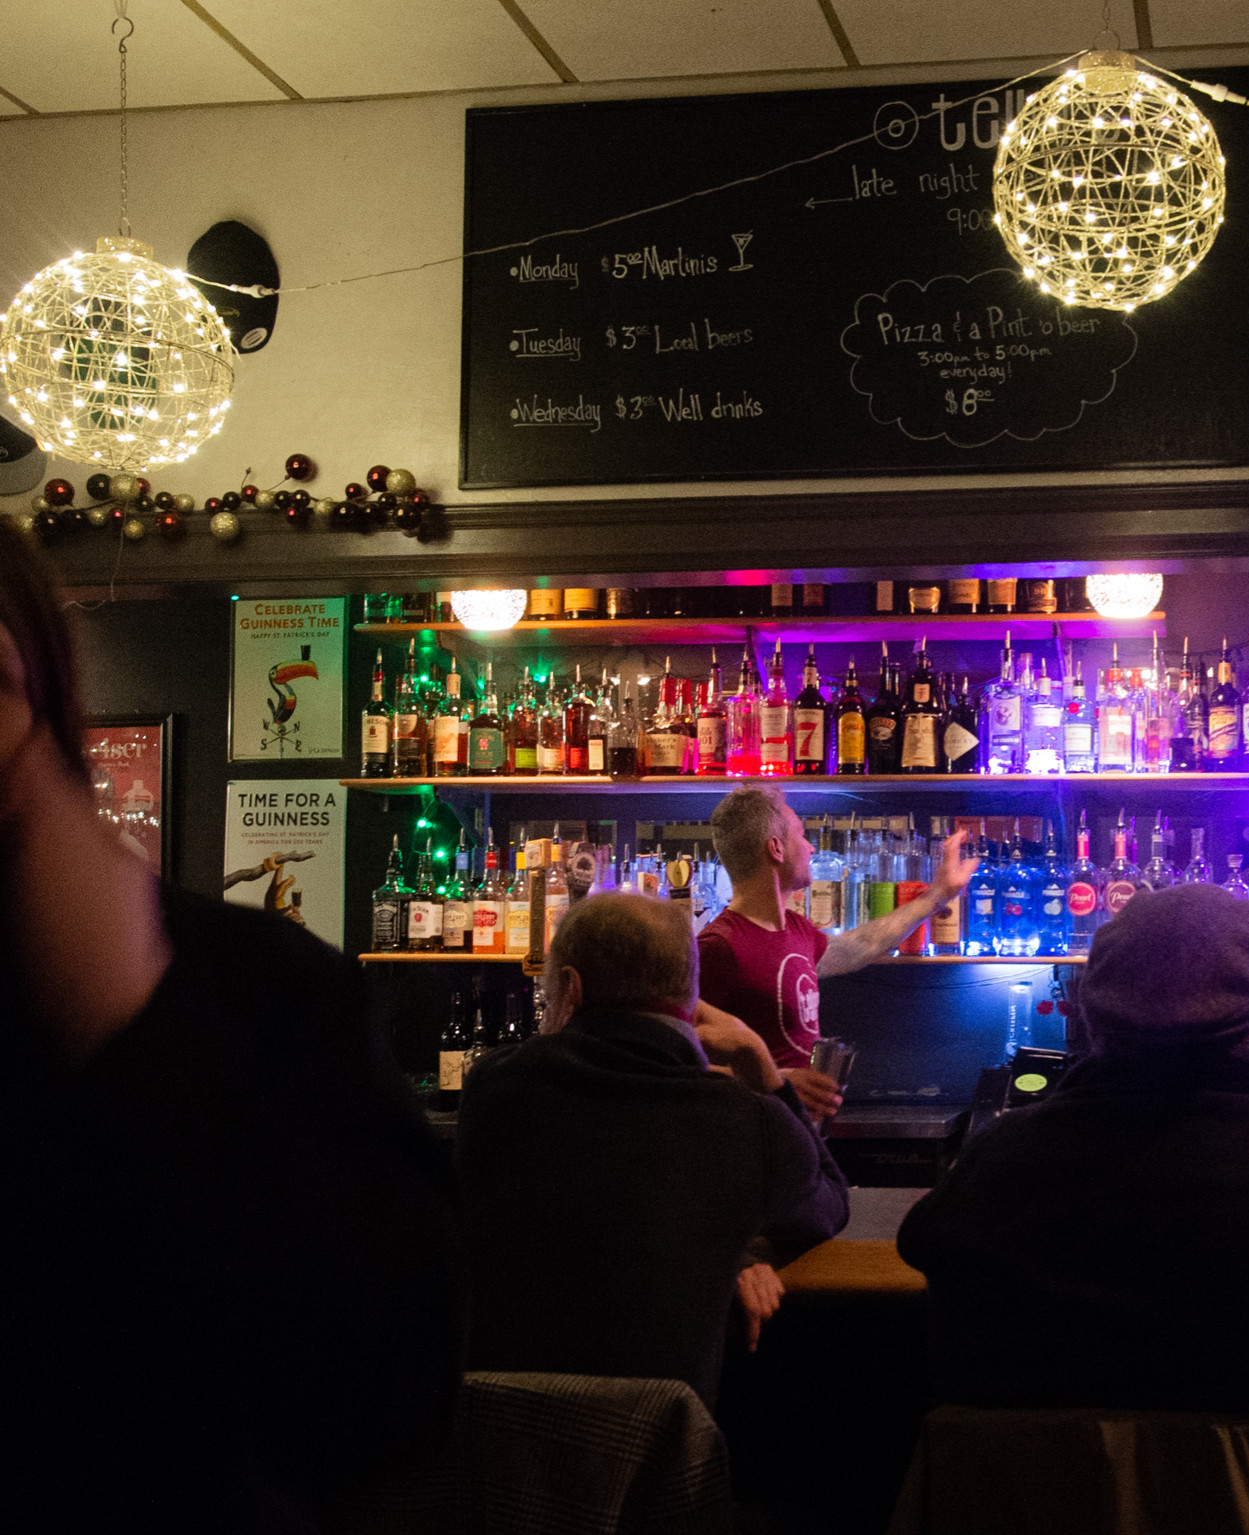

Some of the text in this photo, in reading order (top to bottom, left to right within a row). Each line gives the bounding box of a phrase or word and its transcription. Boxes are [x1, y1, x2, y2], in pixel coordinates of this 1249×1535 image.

[851, 164, 897, 199] late
[919, 163, 980, 200] night
[519, 254, 579, 290] Monday
[877, 312, 944, 345] Pizza
[968, 321, 981, 340] a
[986, 305, 1032, 339] Pint
[1055, 306, 1101, 336] beer
[513, 327, 581, 361] Tuesday
[704, 318, 753, 350] beers
[974, 346, 990, 361] to
[515, 394, 601, 433] Wednesday
[658, 387, 703, 422] Well
[711, 391, 763, 419] drinks
[254, 603, 325, 616] CELEBRATE
[240, 616, 339, 630] GUINNESS TIME
[260, 739, 267, 750] S
[797, 722, 818, 756] 7
[238, 793, 336, 808] TIME FOR A
[243, 811, 330, 827] GUINNESS
